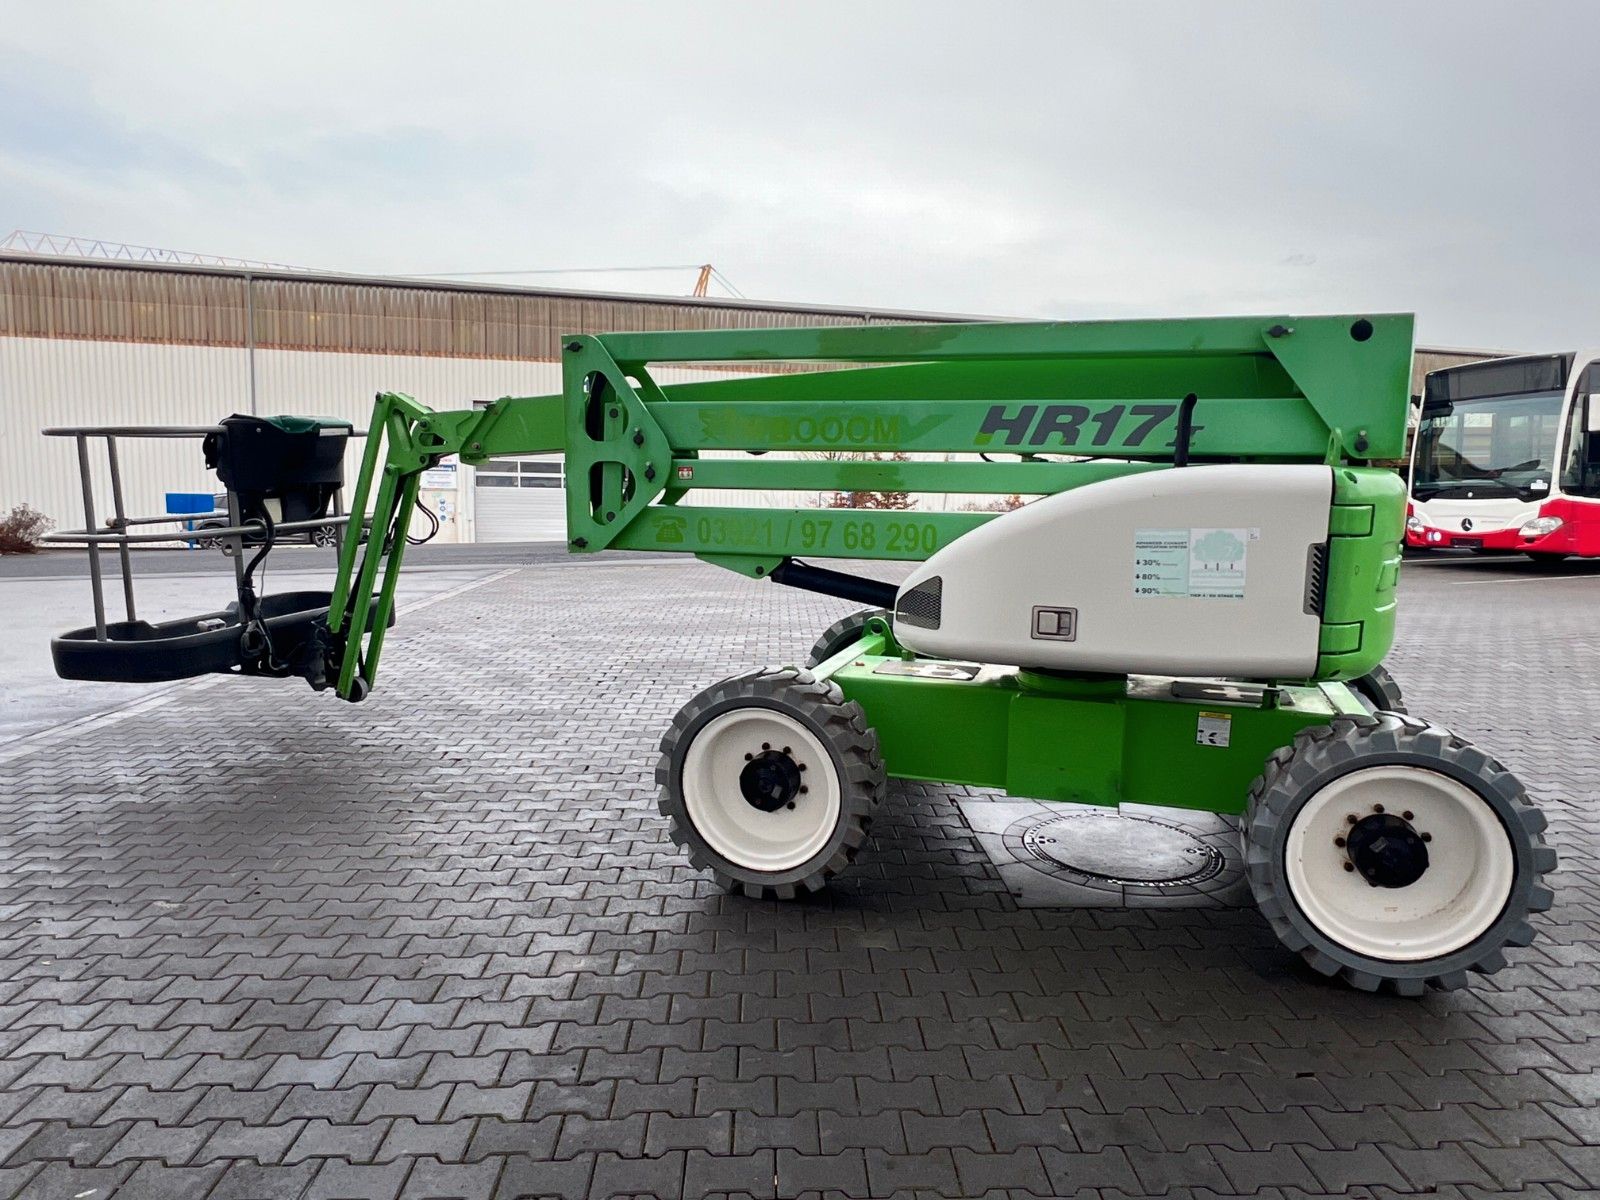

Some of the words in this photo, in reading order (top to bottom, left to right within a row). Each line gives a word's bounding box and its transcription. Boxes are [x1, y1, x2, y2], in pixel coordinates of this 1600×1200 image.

[783, 519, 793, 548] /
[801, 520, 832, 549] 97
[843, 521, 876, 550] 68
[885, 523, 938, 553] 290
